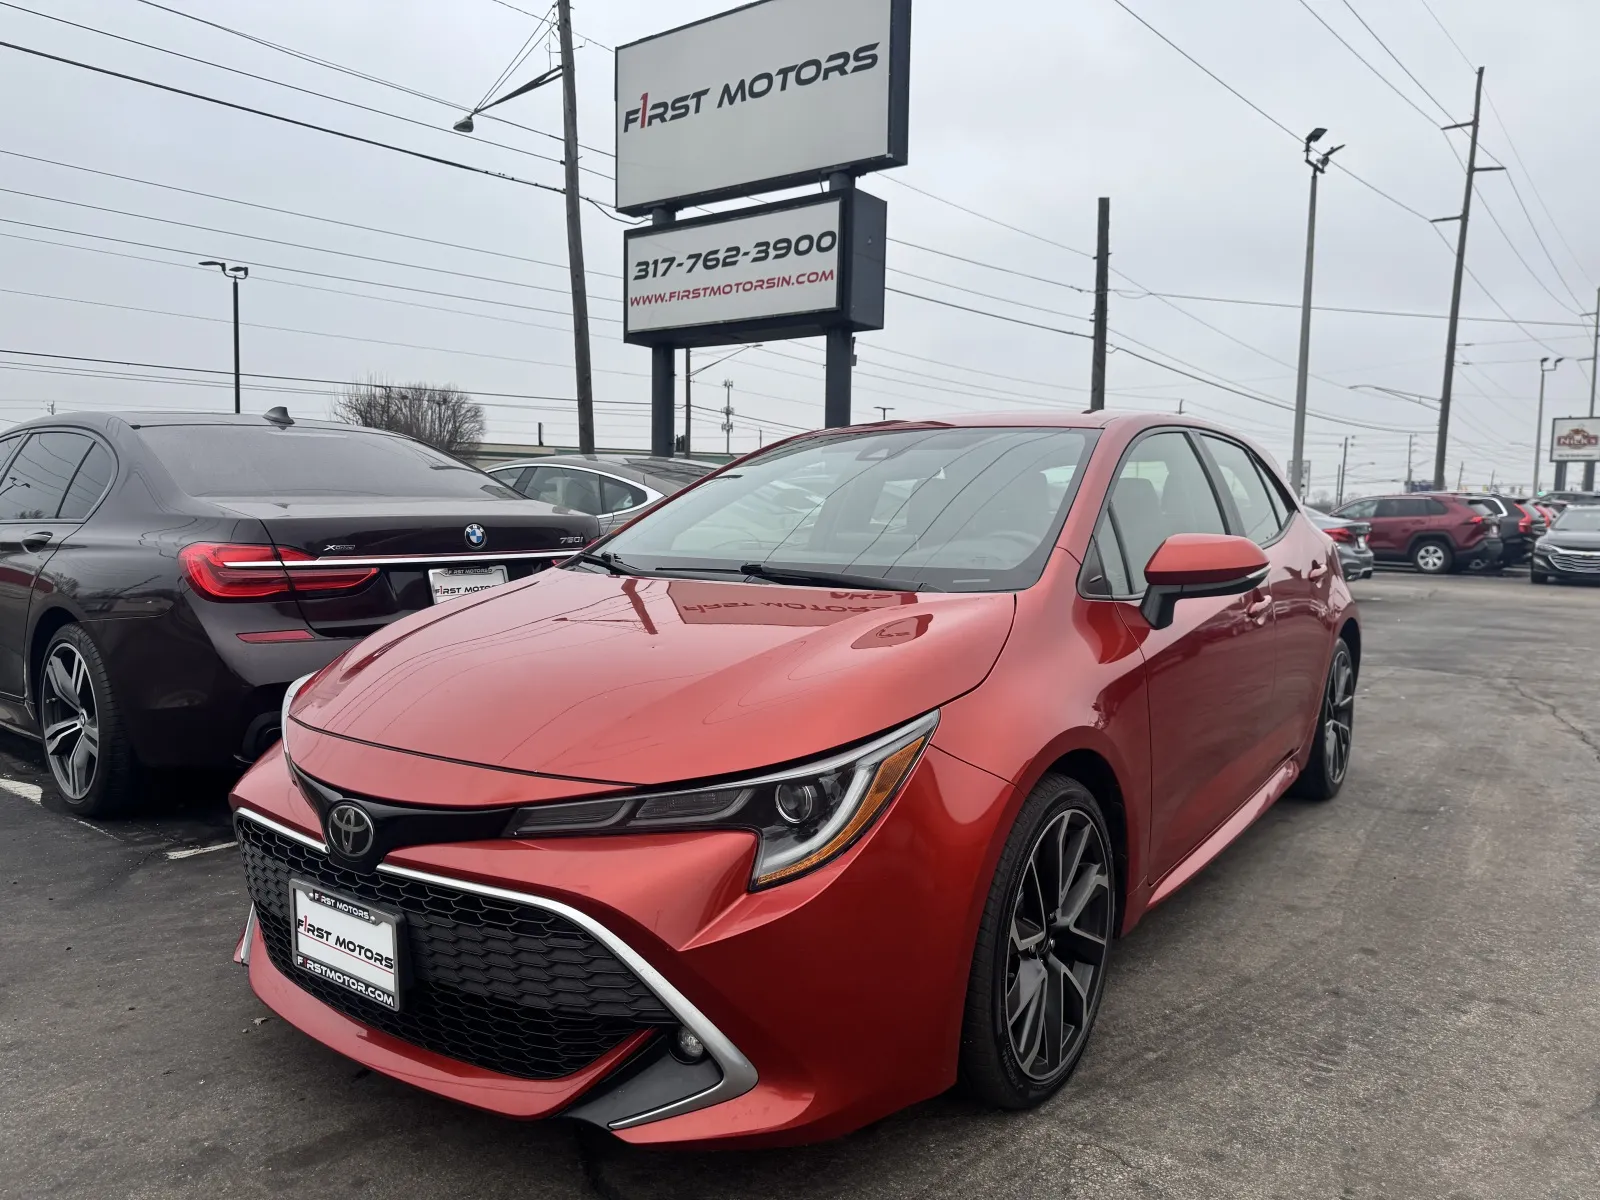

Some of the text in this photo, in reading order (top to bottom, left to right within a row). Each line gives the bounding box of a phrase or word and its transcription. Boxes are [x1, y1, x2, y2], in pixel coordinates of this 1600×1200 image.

[717, 42, 880, 109] MOTORS
[633, 230, 837, 281] 317-762-3900
[630, 269, 834, 307] WWW.FIRSTMOTORSIN.COM
[336, 901, 370, 920] MOTORS
[335, 935, 394, 969] MOTORS
